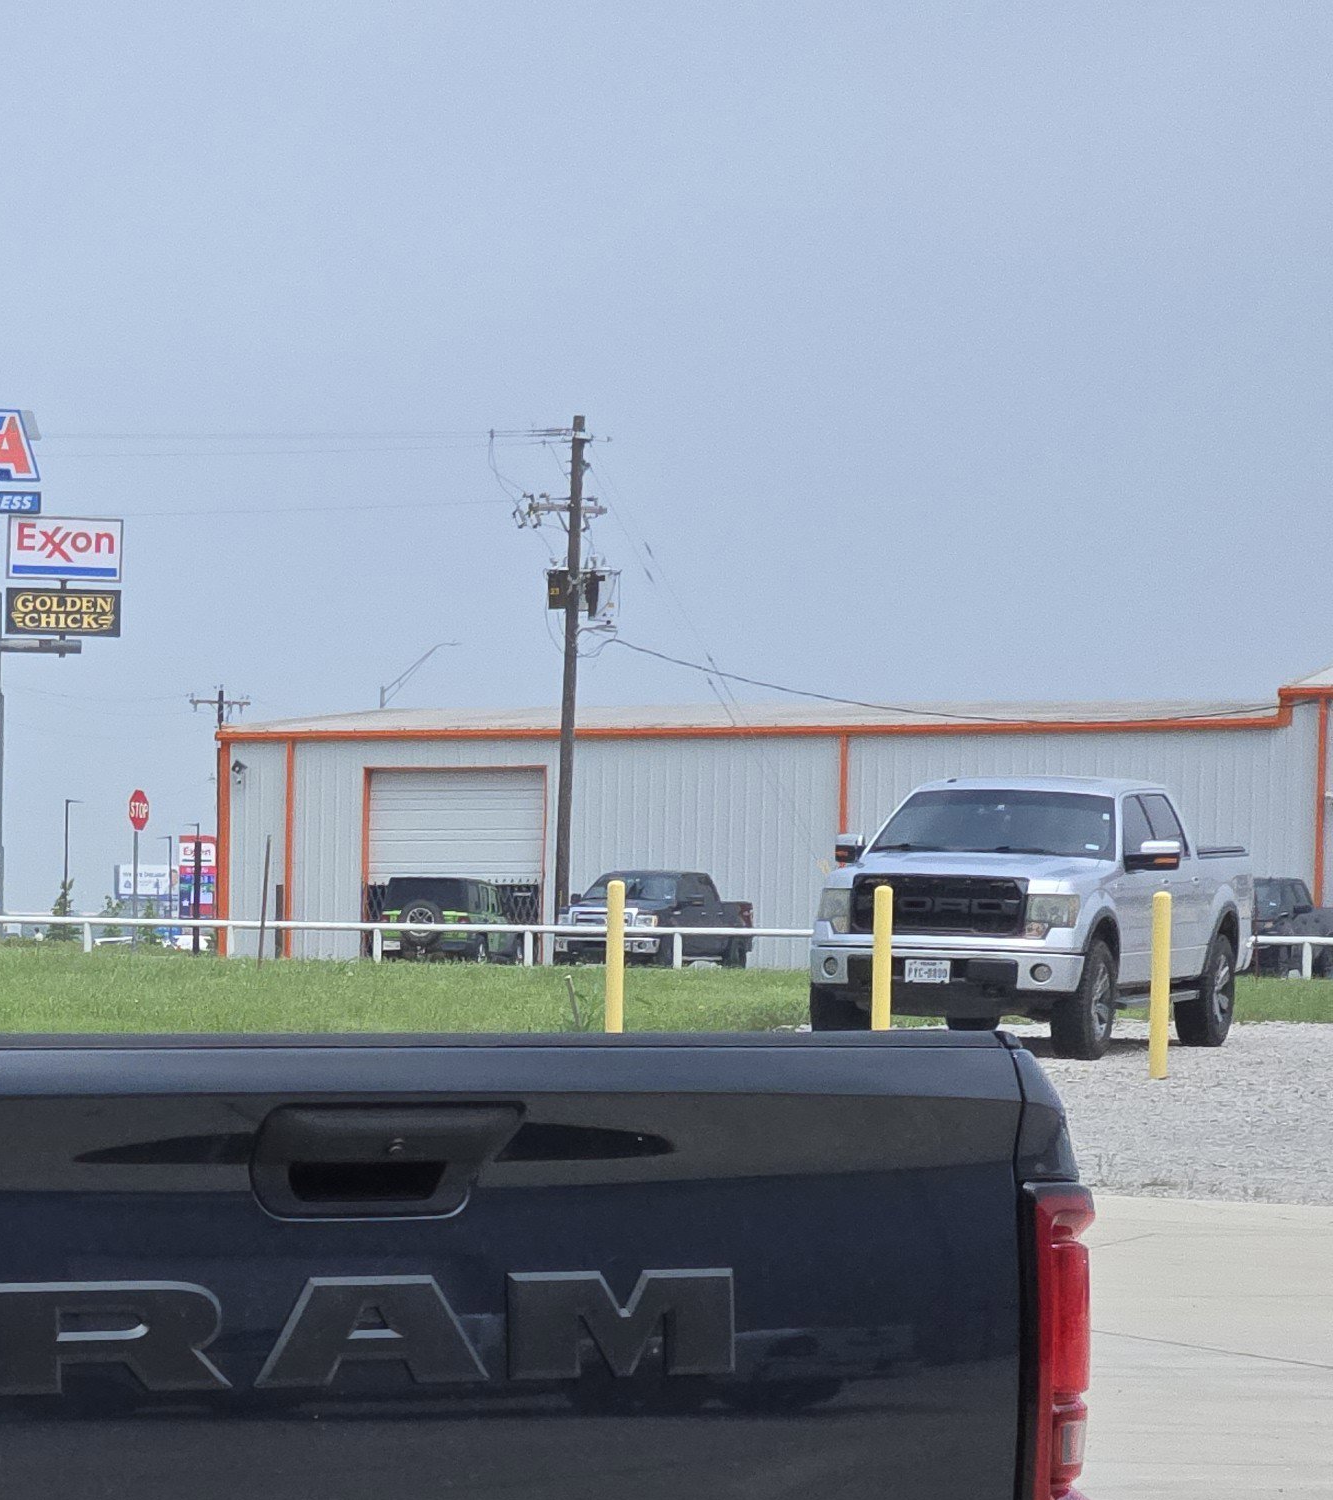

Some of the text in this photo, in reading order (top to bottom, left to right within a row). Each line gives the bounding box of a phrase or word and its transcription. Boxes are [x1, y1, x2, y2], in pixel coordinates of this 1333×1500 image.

[16, 521, 116, 563] Exxon
[16, 592, 113, 614] GOLDEN
[23, 612, 100, 630] CHICK
[130, 801, 148, 819] STOP
